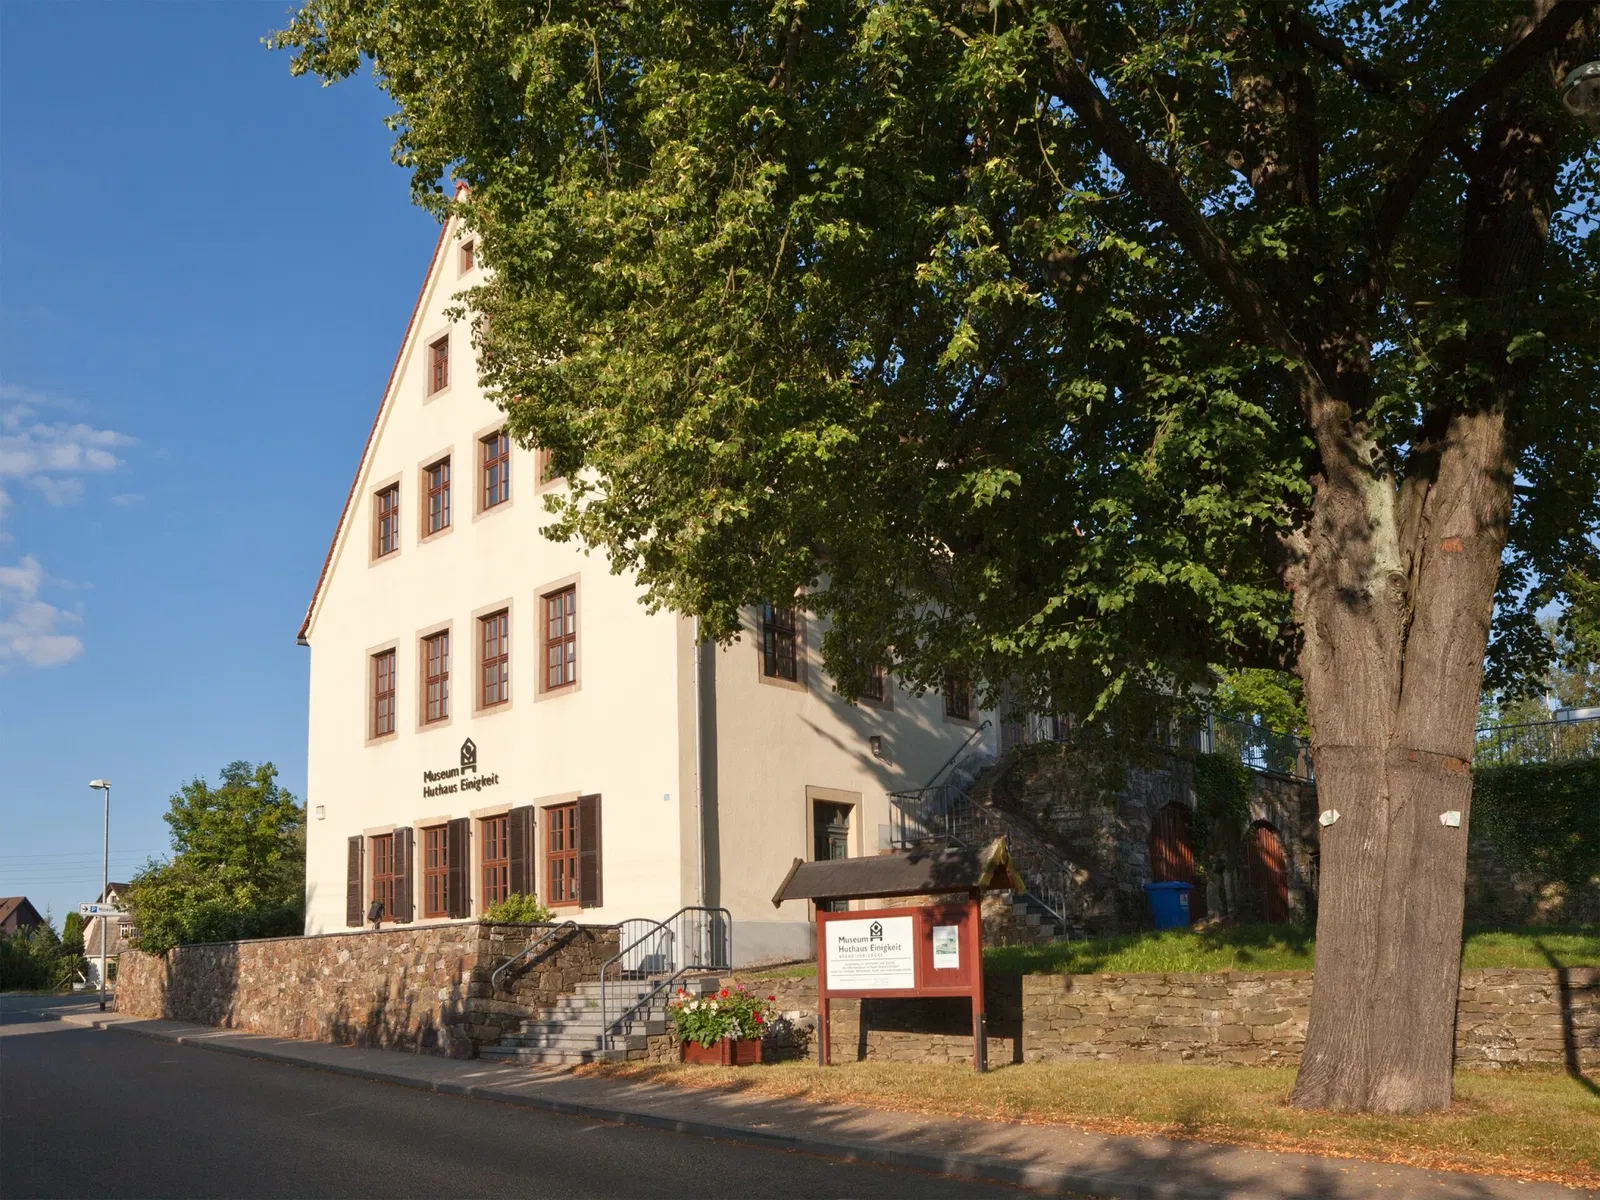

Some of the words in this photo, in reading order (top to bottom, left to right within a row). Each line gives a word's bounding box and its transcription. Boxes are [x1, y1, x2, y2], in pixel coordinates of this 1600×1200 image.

[423, 768, 459, 783] Museum
[423, 783, 458, 798] Huthaus
[460, 772, 499, 792] Einigkeit
[838, 936, 869, 944] Museum
[838, 945, 868, 953] Huthaus
[870, 943, 902, 953] Einigkeit
